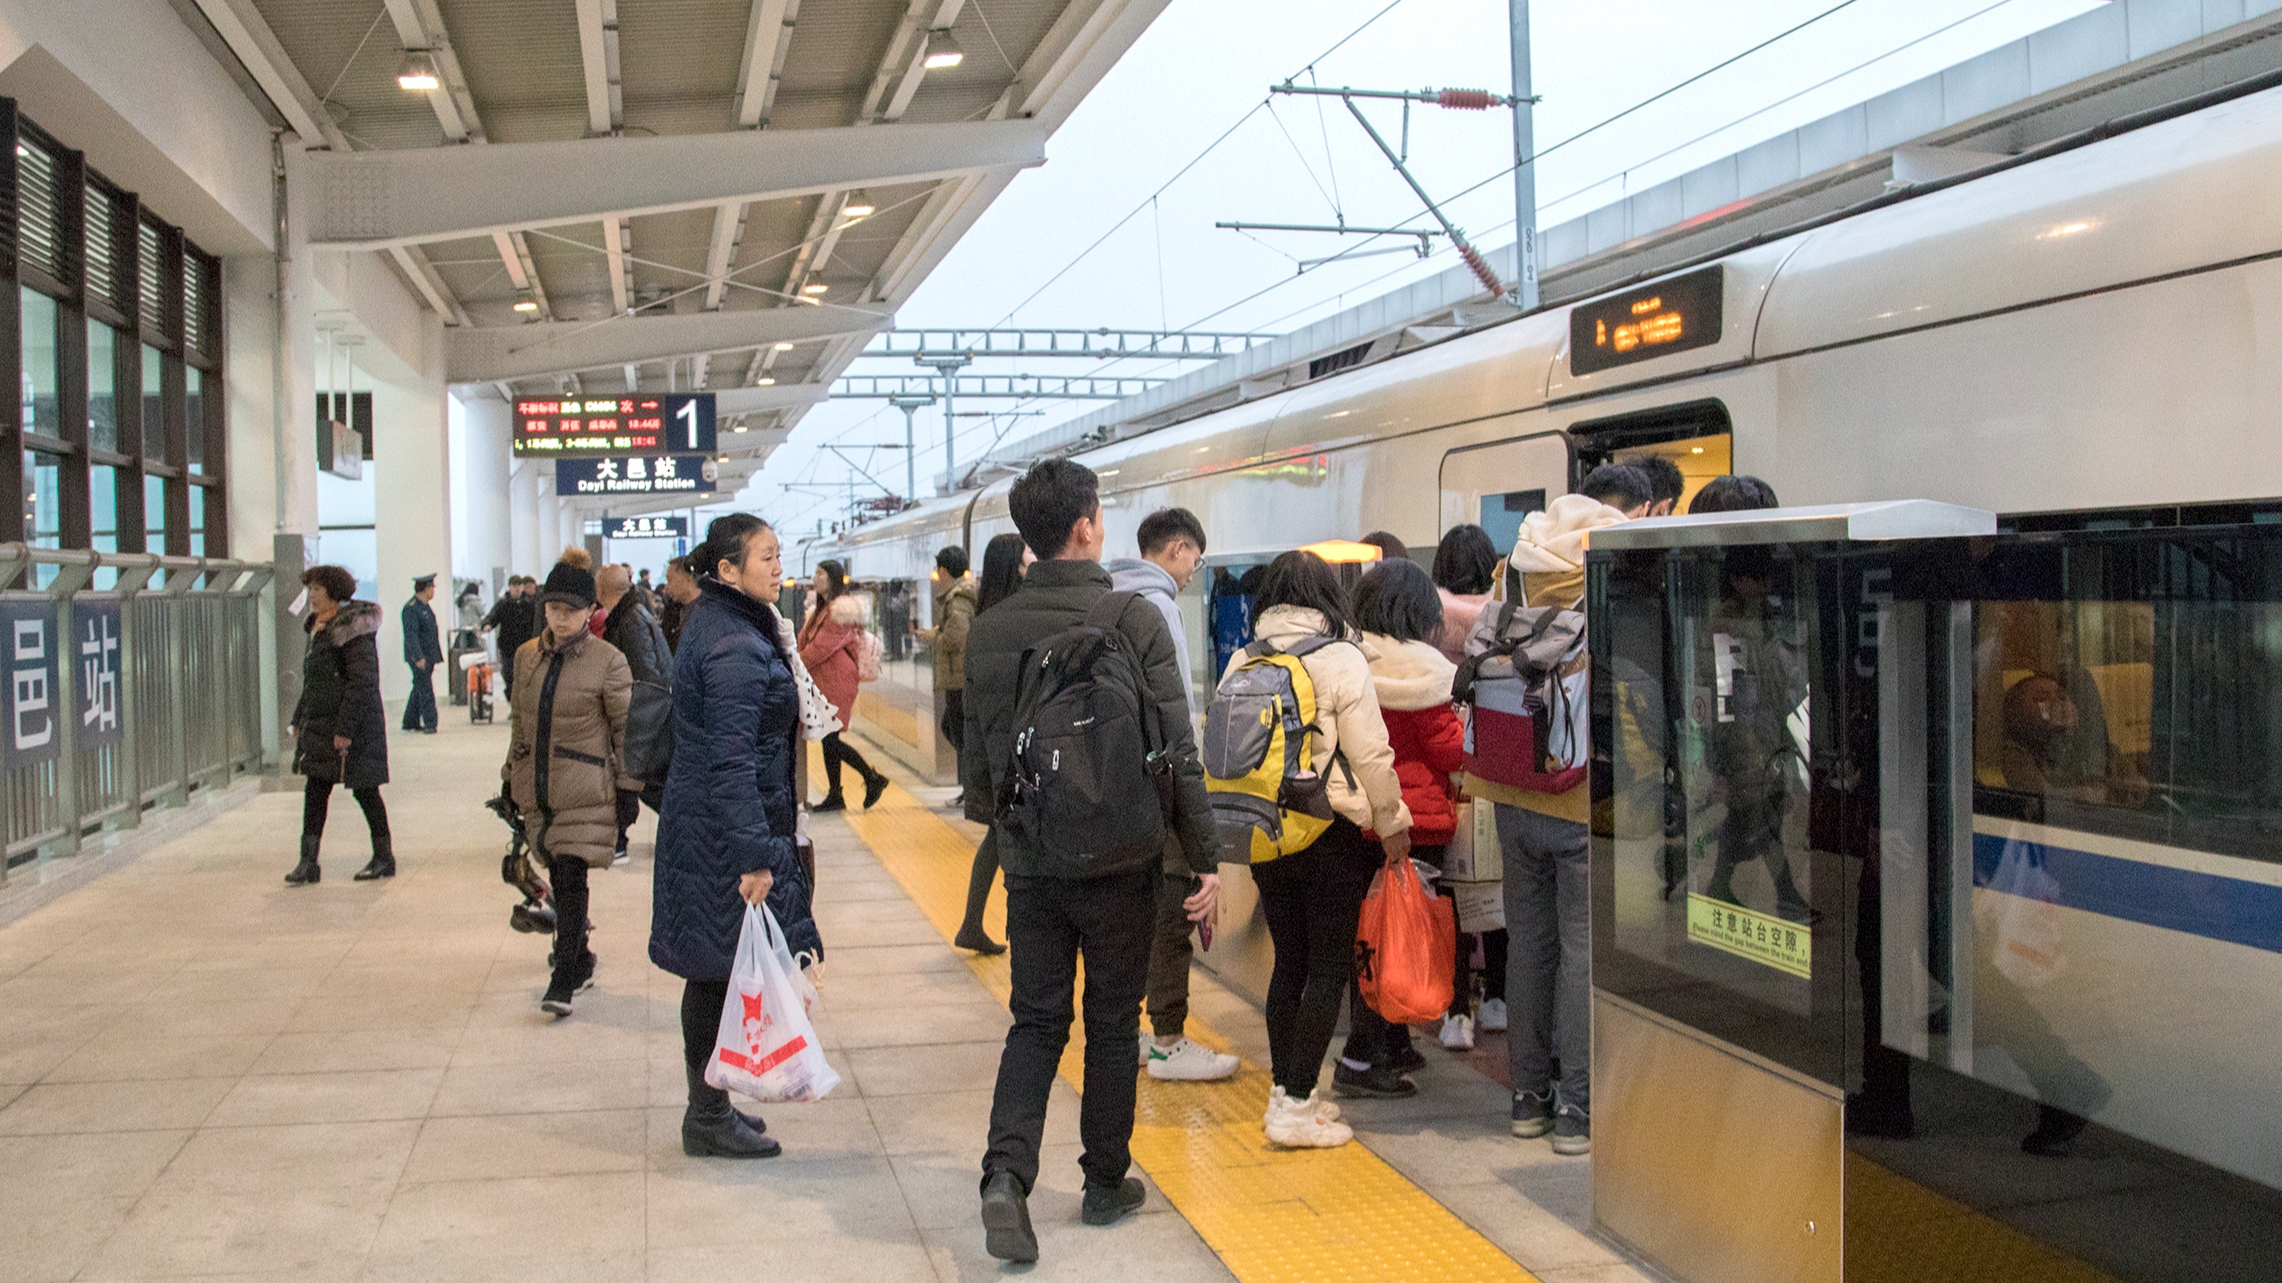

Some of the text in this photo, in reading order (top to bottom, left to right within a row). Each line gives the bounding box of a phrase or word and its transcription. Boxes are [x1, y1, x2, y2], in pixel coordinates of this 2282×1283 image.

[676, 399, 698, 449] 1
[597, 457, 676, 479] 大邑站
[578, 478, 696, 492] Dayi Railway Station
[622, 519, 667, 531] 大邑站
[1725, 932, 1733, 942] the
[1734, 936, 1744, 948] gap
[1746, 938, 1770, 954] between
[1771, 946, 1780, 957] the
[1781, 950, 1795, 963] train
